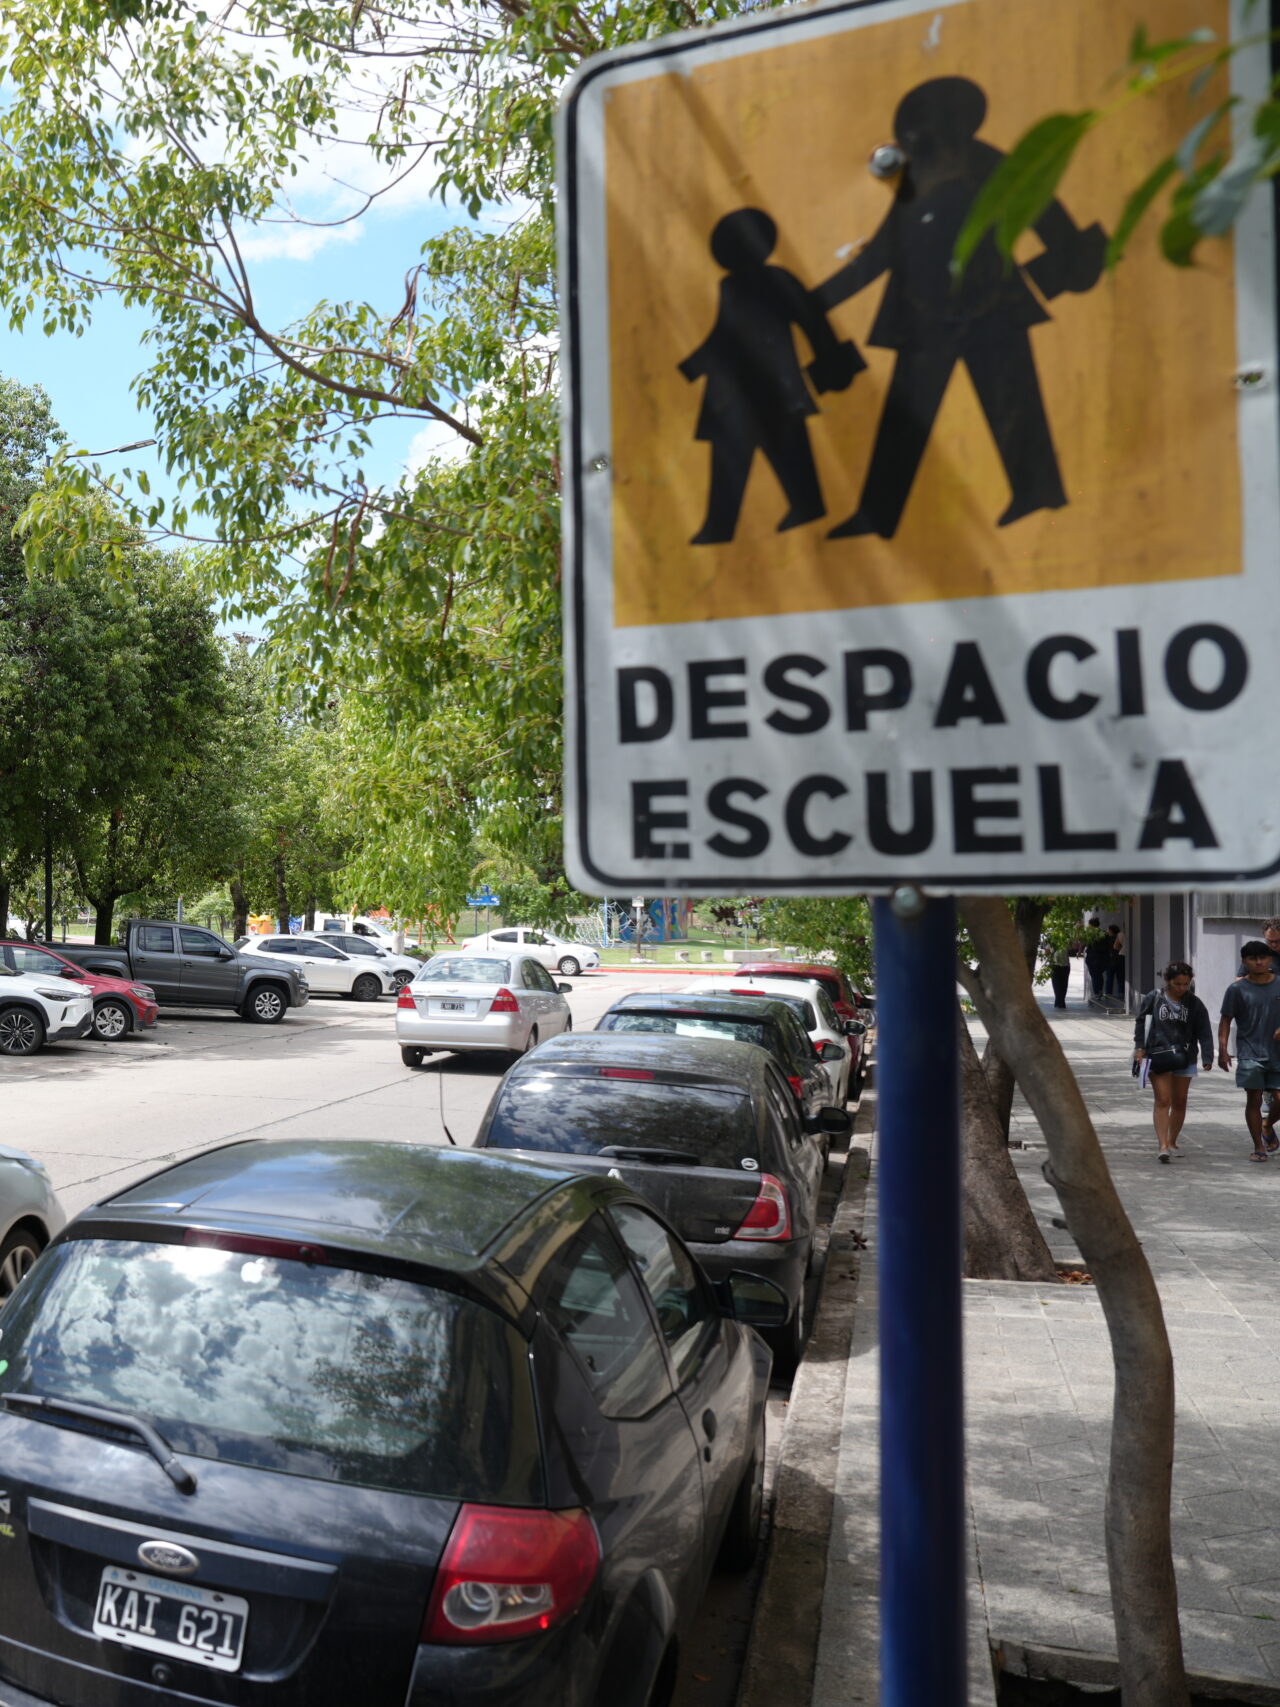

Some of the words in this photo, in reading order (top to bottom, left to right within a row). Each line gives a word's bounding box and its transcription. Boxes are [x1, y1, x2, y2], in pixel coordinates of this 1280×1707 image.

[618, 624, 1249, 745] DESPACIO
[631, 760, 1219, 860] ESCUELA
[150, 1549, 183, 1567] Ford
[101, 1584, 161, 1636] KAI
[177, 1605, 234, 1657] 621
